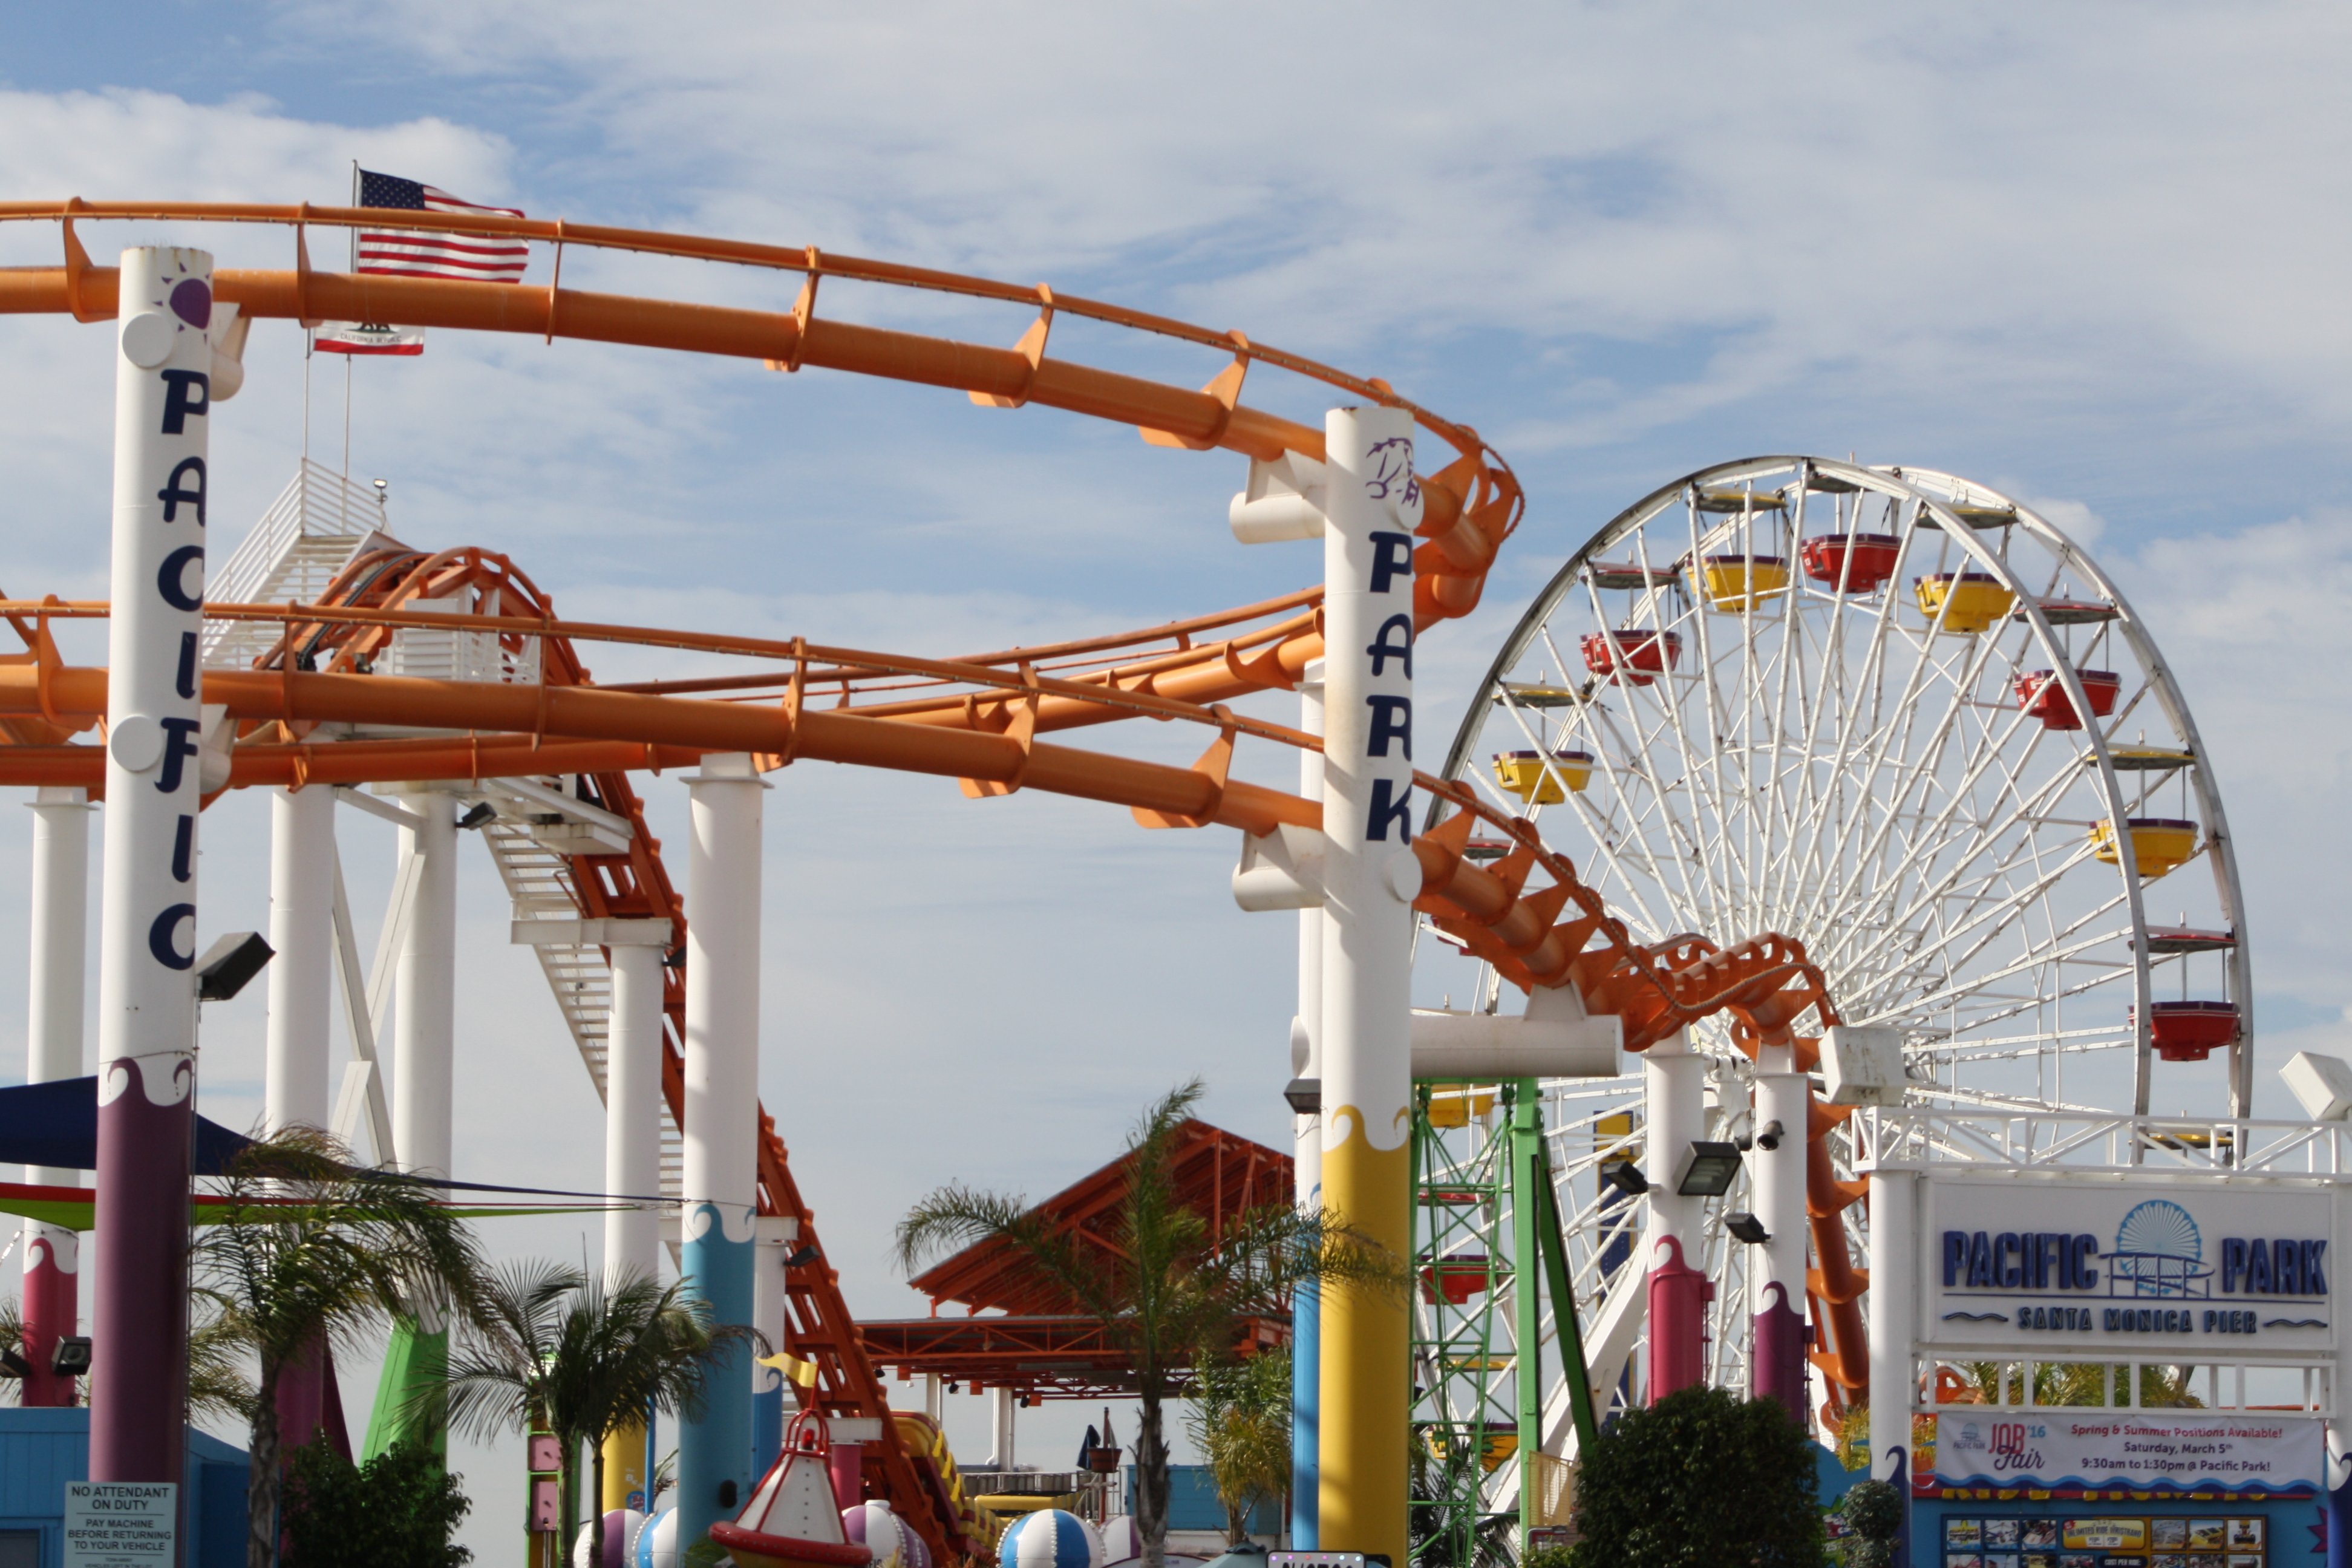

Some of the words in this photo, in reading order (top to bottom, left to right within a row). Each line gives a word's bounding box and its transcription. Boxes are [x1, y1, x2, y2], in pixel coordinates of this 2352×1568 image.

[149, 368, 210, 971] PACIFIC
[1365, 531, 1413, 846] PARK
[1942, 1230, 2099, 1290] PACIFIC
[2222, 1237, 2328, 1295] PARK
[2018, 1307, 2092, 1330] SANTA
[2103, 1308, 2194, 1332] MONICA
[2204, 1310, 2257, 1333] PIER
[1988, 1423, 2025, 1454] JOB
[2071, 1425, 2109, 1437] Spring
[2112, 1425, 2120, 1434] &
[2124, 1425, 2171, 1437] Summer
[2174, 1426, 2225, 1437] Positions
[2227, 1427, 2283, 1439] Available!
[2124, 1442, 2178, 1455] Saturday,
[2181, 1443, 2215, 1453] March
[1994, 1445, 2045, 1471] Fair
[2082, 1458, 2125, 1469] 9:30am
[2129, 1459, 2141, 1469] to
[2143, 1459, 2185, 1472] 1:30pm
[2187, 1462, 2197, 1471] @
[2200, 1460, 2239, 1471] Pacific
[2241, 1461, 2270, 1472] Park!
[72, 1486, 90, 1497] NO
[94, 1487, 169, 1497] ATTENDANT
[93, 1500, 110, 1509] ON
[114, 1500, 149, 1510] DUTY
[108, 1520, 154, 1528] MACHINE
[68, 1530, 109, 1538] BEFORE
[113, 1530, 171, 1540] RETURNING
[74, 1541, 87, 1549] TO
[91, 1541, 119, 1550] YOUR
[122, 1542, 165, 1550] VEHICLE
